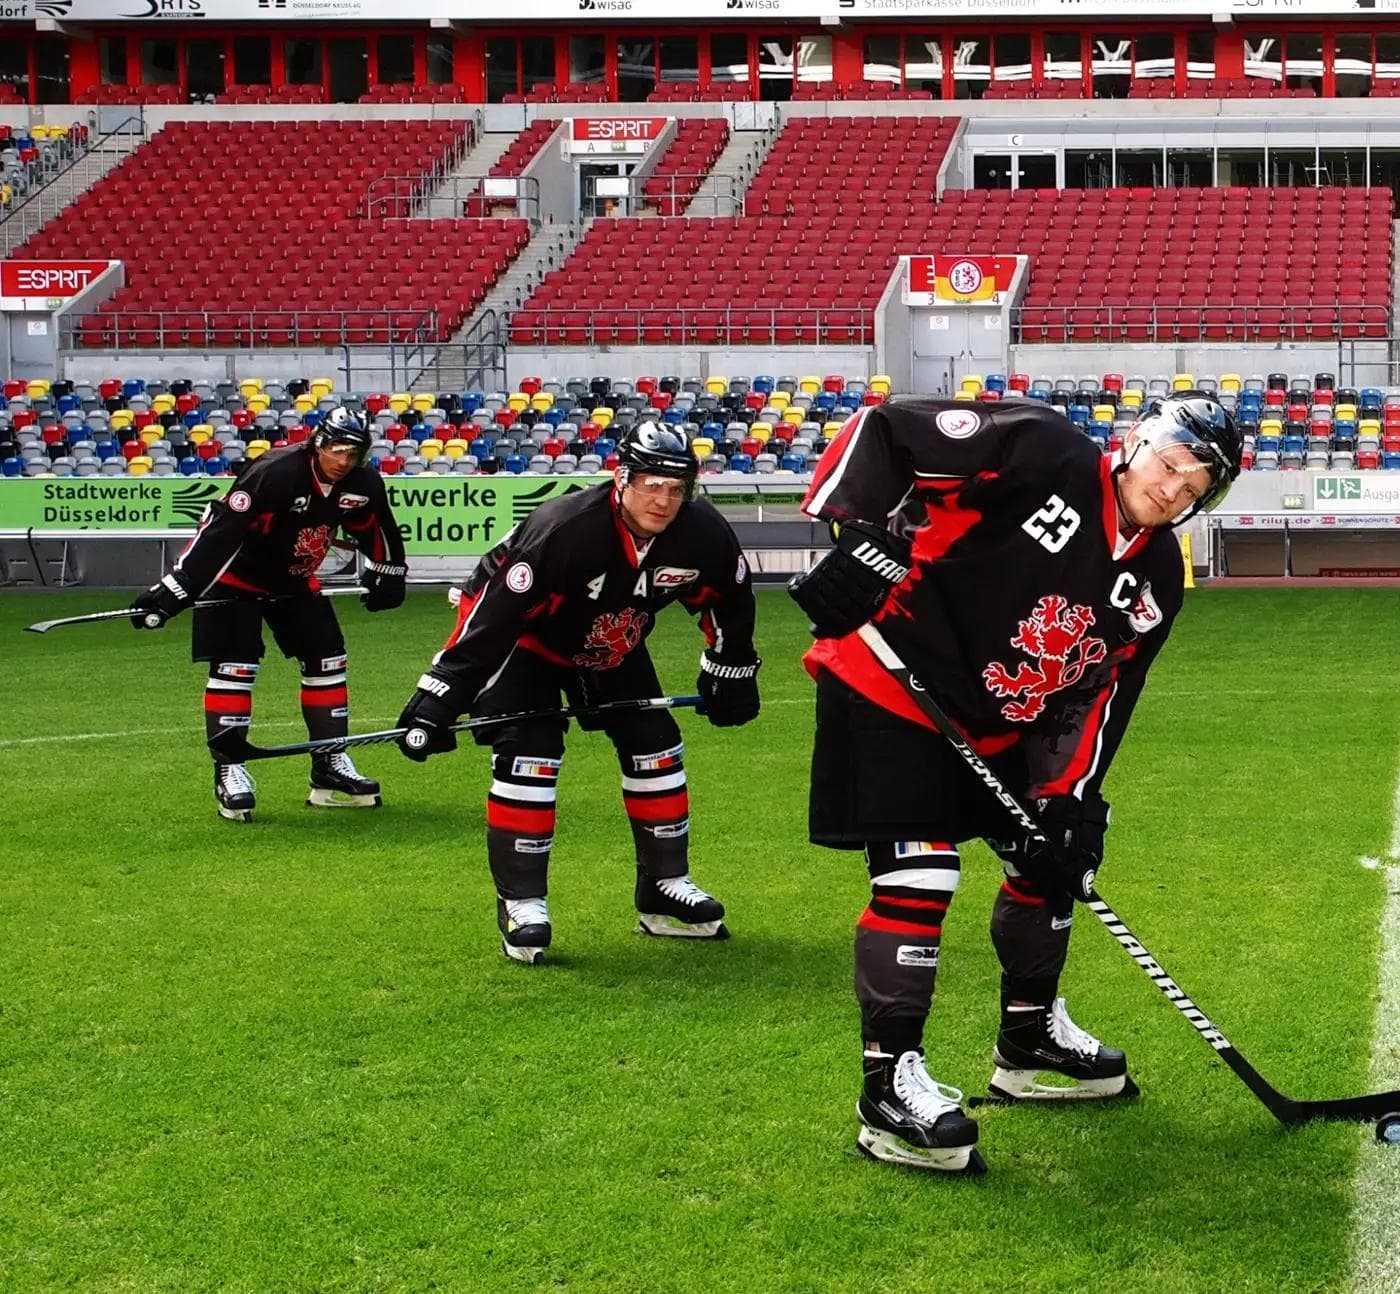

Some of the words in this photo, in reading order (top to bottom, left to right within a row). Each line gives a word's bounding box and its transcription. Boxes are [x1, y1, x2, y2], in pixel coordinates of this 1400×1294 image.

[588, 120, 652, 138] ESPRIT
[587, 142, 596, 152] A
[644, 141, 651, 152] B
[1011, 135, 1019, 146] C
[17, 269, 92, 289] ESPRIT
[21, 297, 27, 311] 1
[927, 292, 935, 306] 3
[992, 292, 1000, 305] 4
[43, 483, 162, 501] Stadtwerke
[44, 505, 162, 524] Düsseldorf
[1021, 493, 1082, 554] 23
[633, 570, 647, 597] A
[1109, 571, 1138, 609] C
[1094, 905, 1232, 1052] WARRIOR
